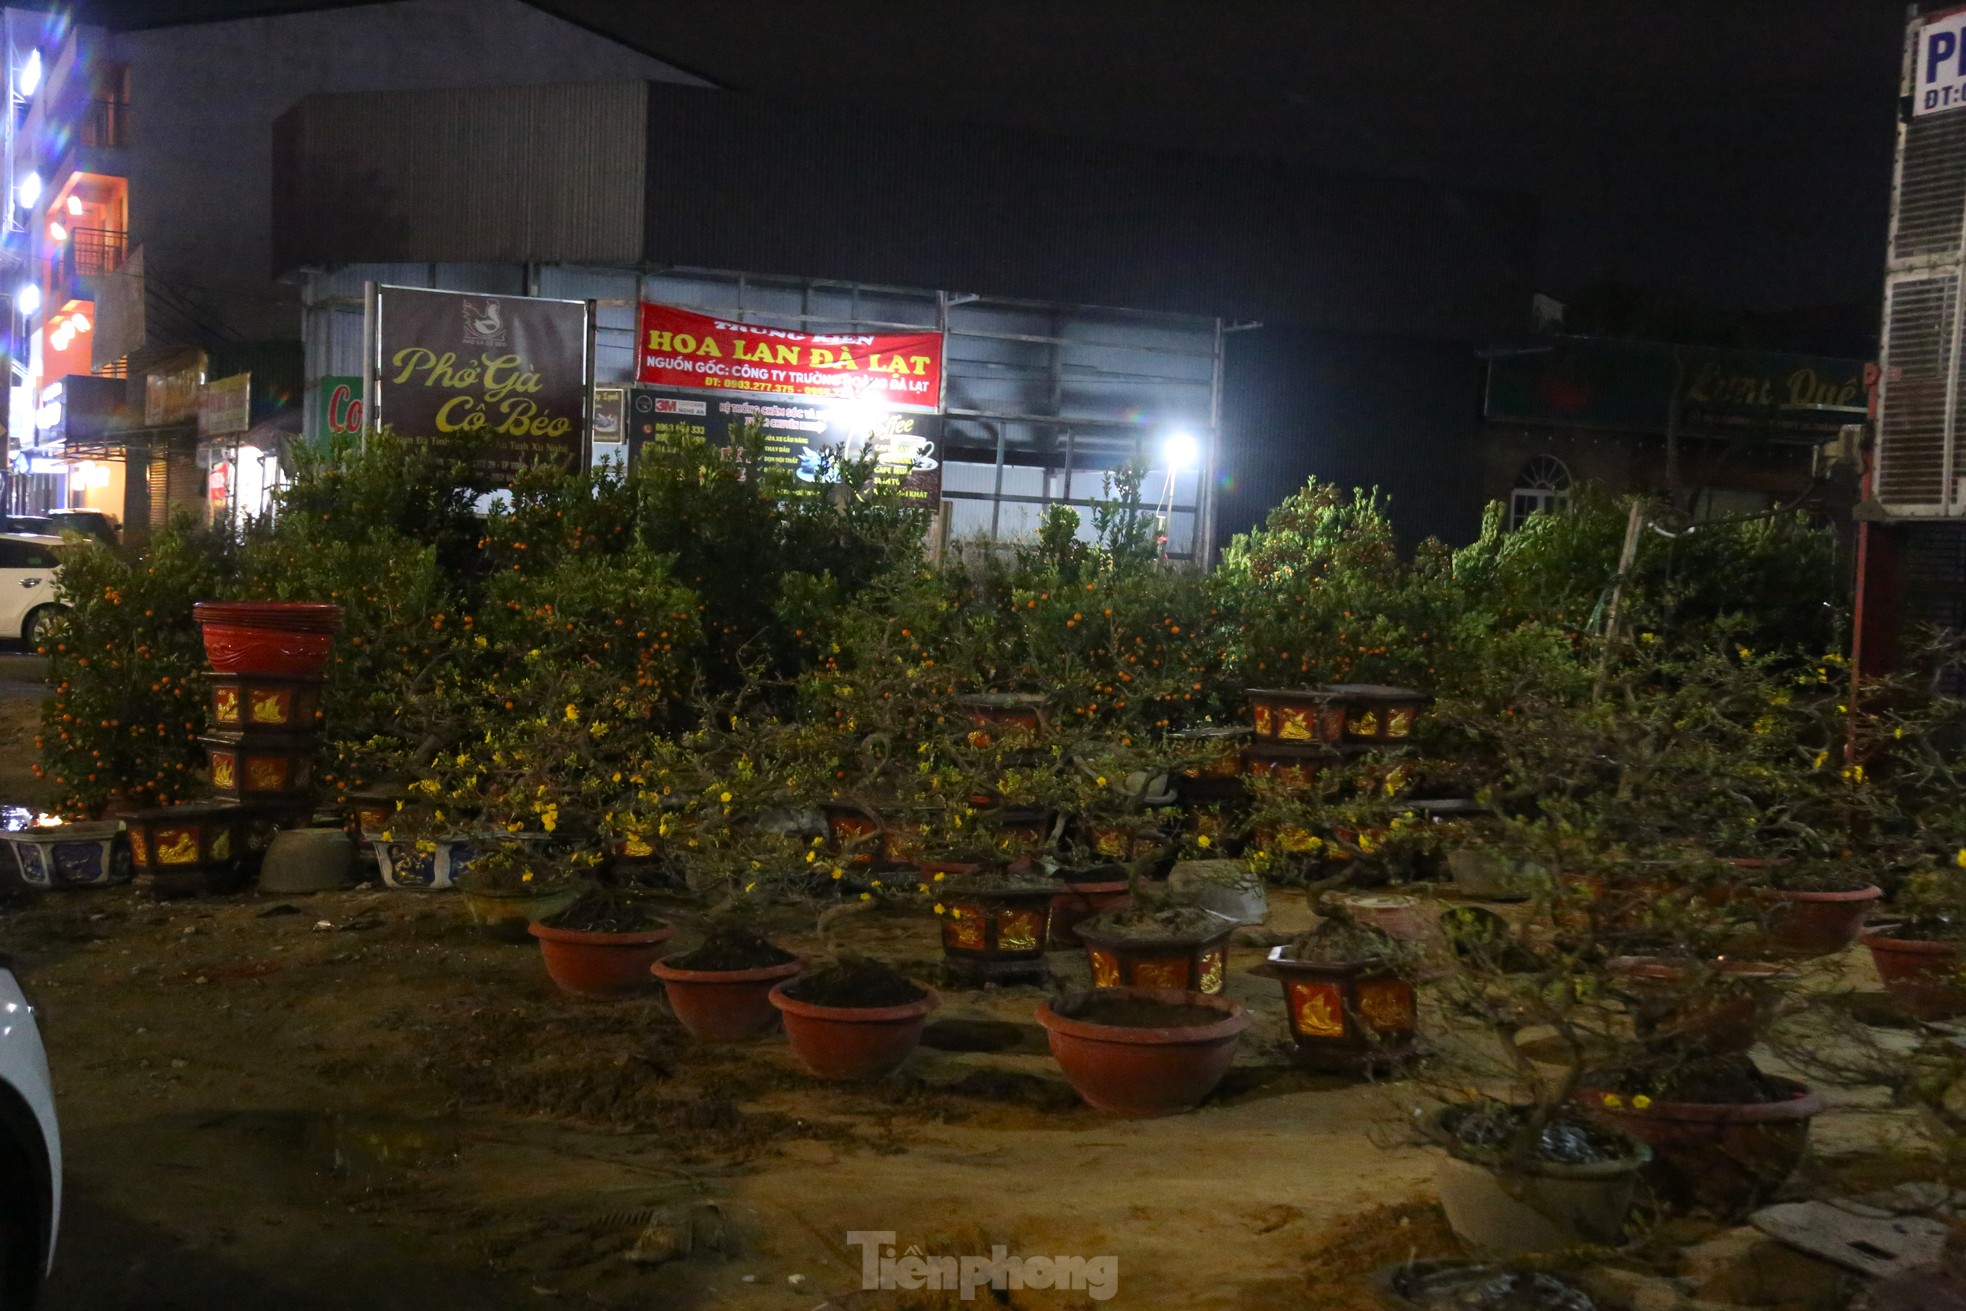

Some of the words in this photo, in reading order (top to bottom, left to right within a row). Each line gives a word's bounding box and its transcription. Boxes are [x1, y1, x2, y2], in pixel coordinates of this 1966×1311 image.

[1926, 25, 1966, 84] P
[392, 347, 482, 389] Phở
[481, 351, 544, 402] Gà
[648, 329, 723, 358] HOA
[732, 339, 801, 366] LAN
[809, 345, 859, 371] ĐÀ
[867, 353, 931, 379] LẠT
[695, 359, 729, 375] GỐC:
[731, 365, 769, 379] CÔNG
[771, 369, 786, 381] TY
[909, 380, 930, 394] LẠT
[724, 379, 794, 394] 0903.277.375
[435, 395, 490, 433] Cô
[494, 397, 572, 437] Béo
[656, 400, 677, 412] 3M
